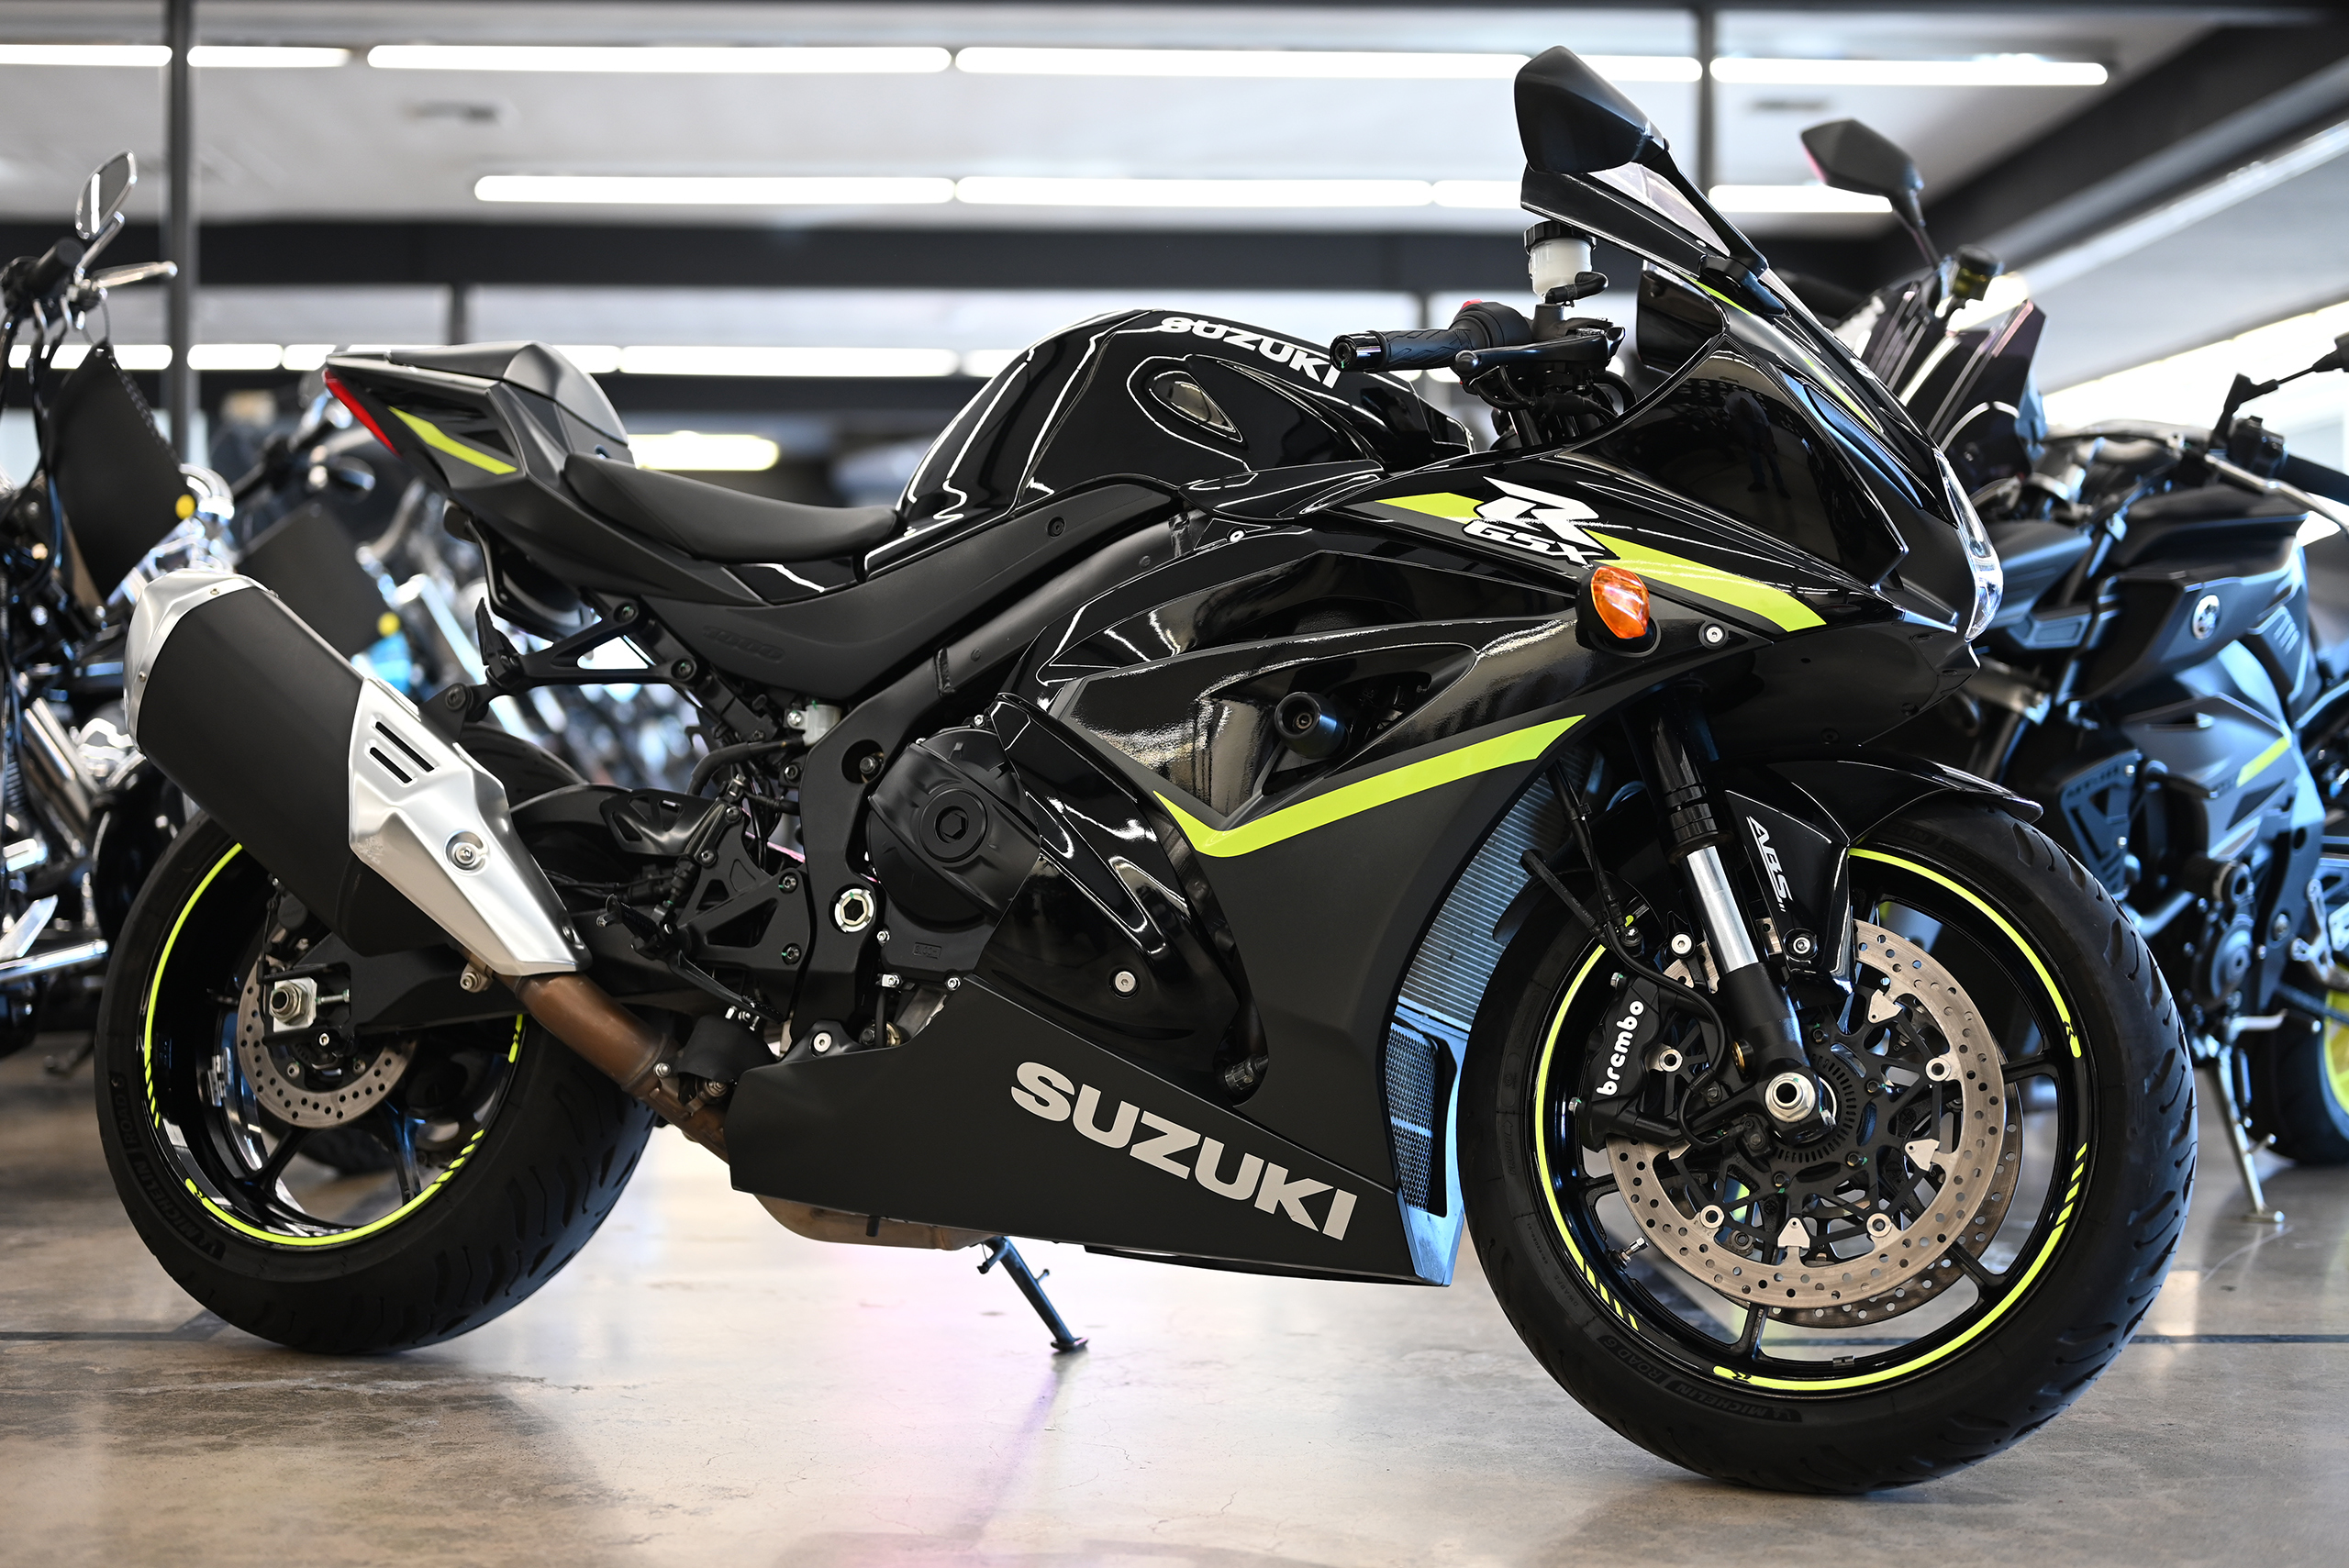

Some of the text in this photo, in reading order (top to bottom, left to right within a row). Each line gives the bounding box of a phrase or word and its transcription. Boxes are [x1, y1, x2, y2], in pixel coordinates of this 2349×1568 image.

[1161, 317, 1341, 389] SUZUKI
[1463, 518, 1605, 567] GSX
[1746, 816, 1793, 903] ABS
[1943, 842, 1987, 873] 120/70
[1597, 1000, 1644, 1095] brembo
[115, 1094, 137, 1145] ROAD
[1011, 1062, 1358, 1240] SUZUKI
[1504, 1137, 1517, 1175] FRONT
[133, 1161, 200, 1240] MICHELIN
[1603, 1338, 1769, 1418] MICHELIN ROAD 6
